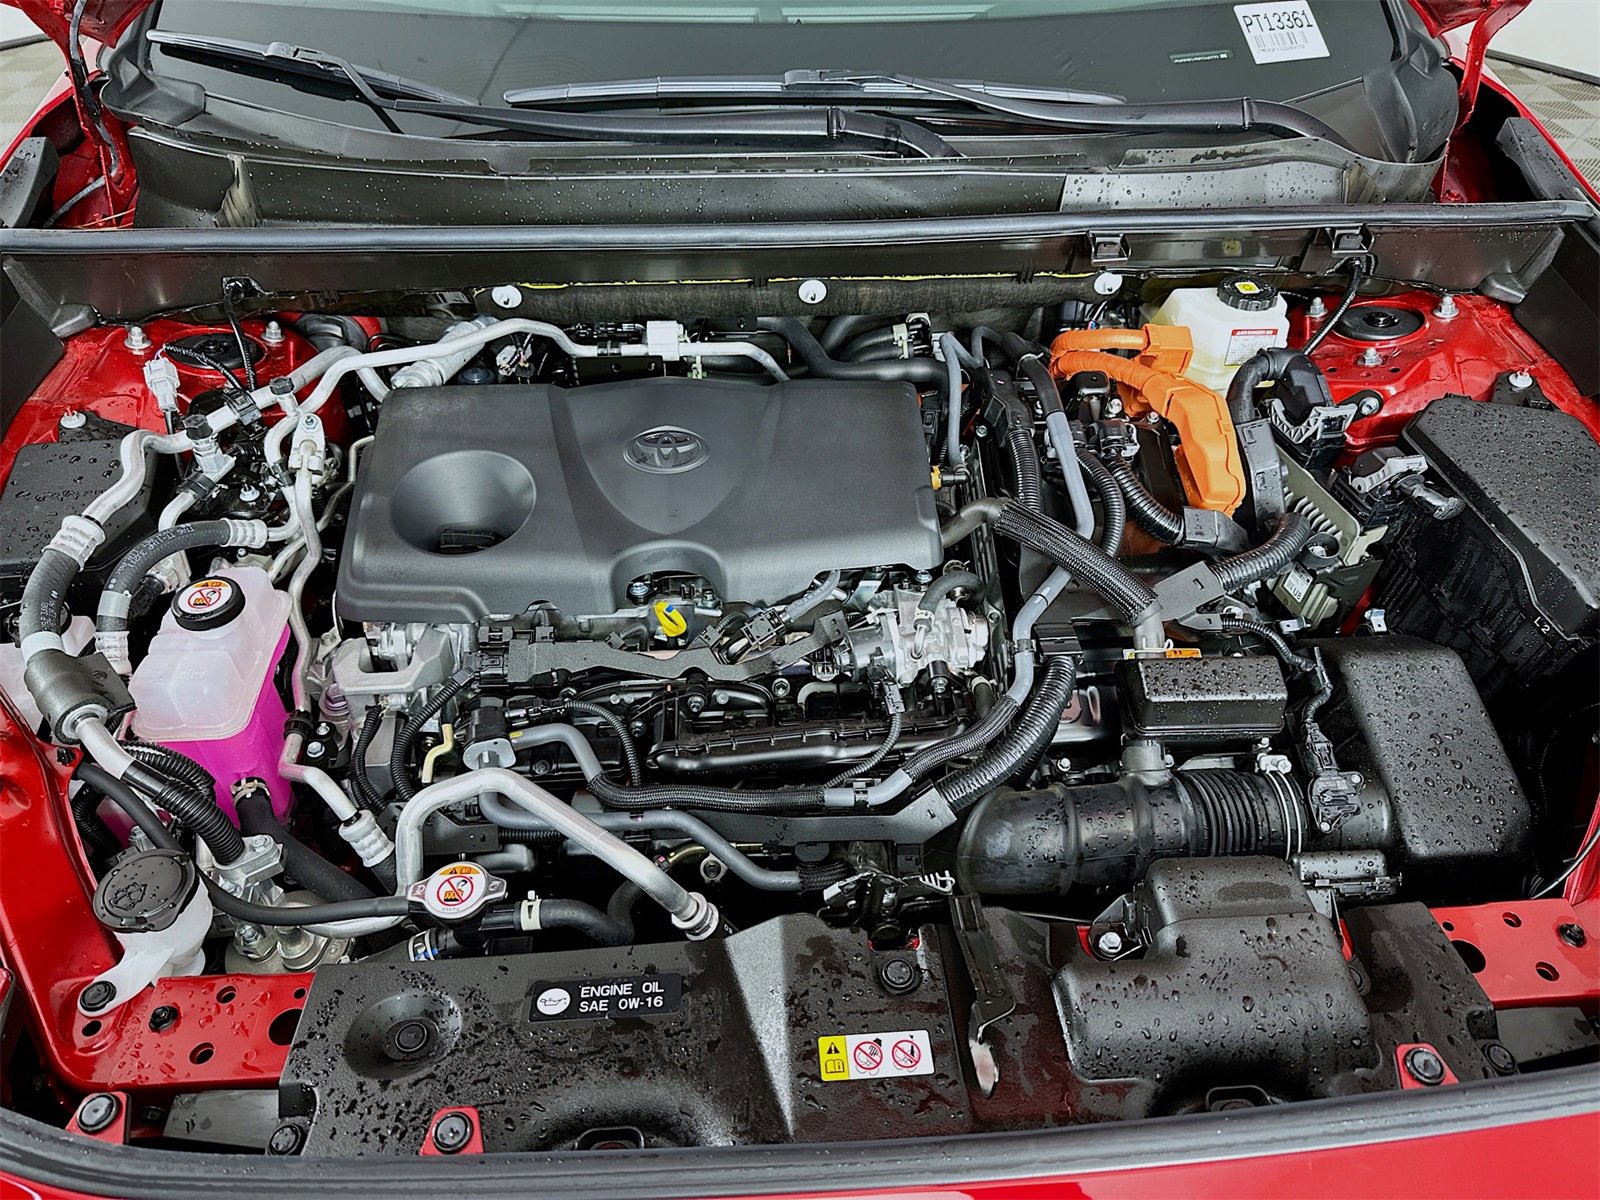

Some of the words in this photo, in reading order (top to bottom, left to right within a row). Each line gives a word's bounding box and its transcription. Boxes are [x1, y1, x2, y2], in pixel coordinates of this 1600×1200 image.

[1242, 10, 1313, 33] PT13361
[1534, 616, 1551, 634] L2
[580, 983, 633, 998] ENGINE
[642, 981, 665, 994] OIL
[579, 1000, 609, 1013] SAE
[618, 996, 664, 1010] 0W-16
